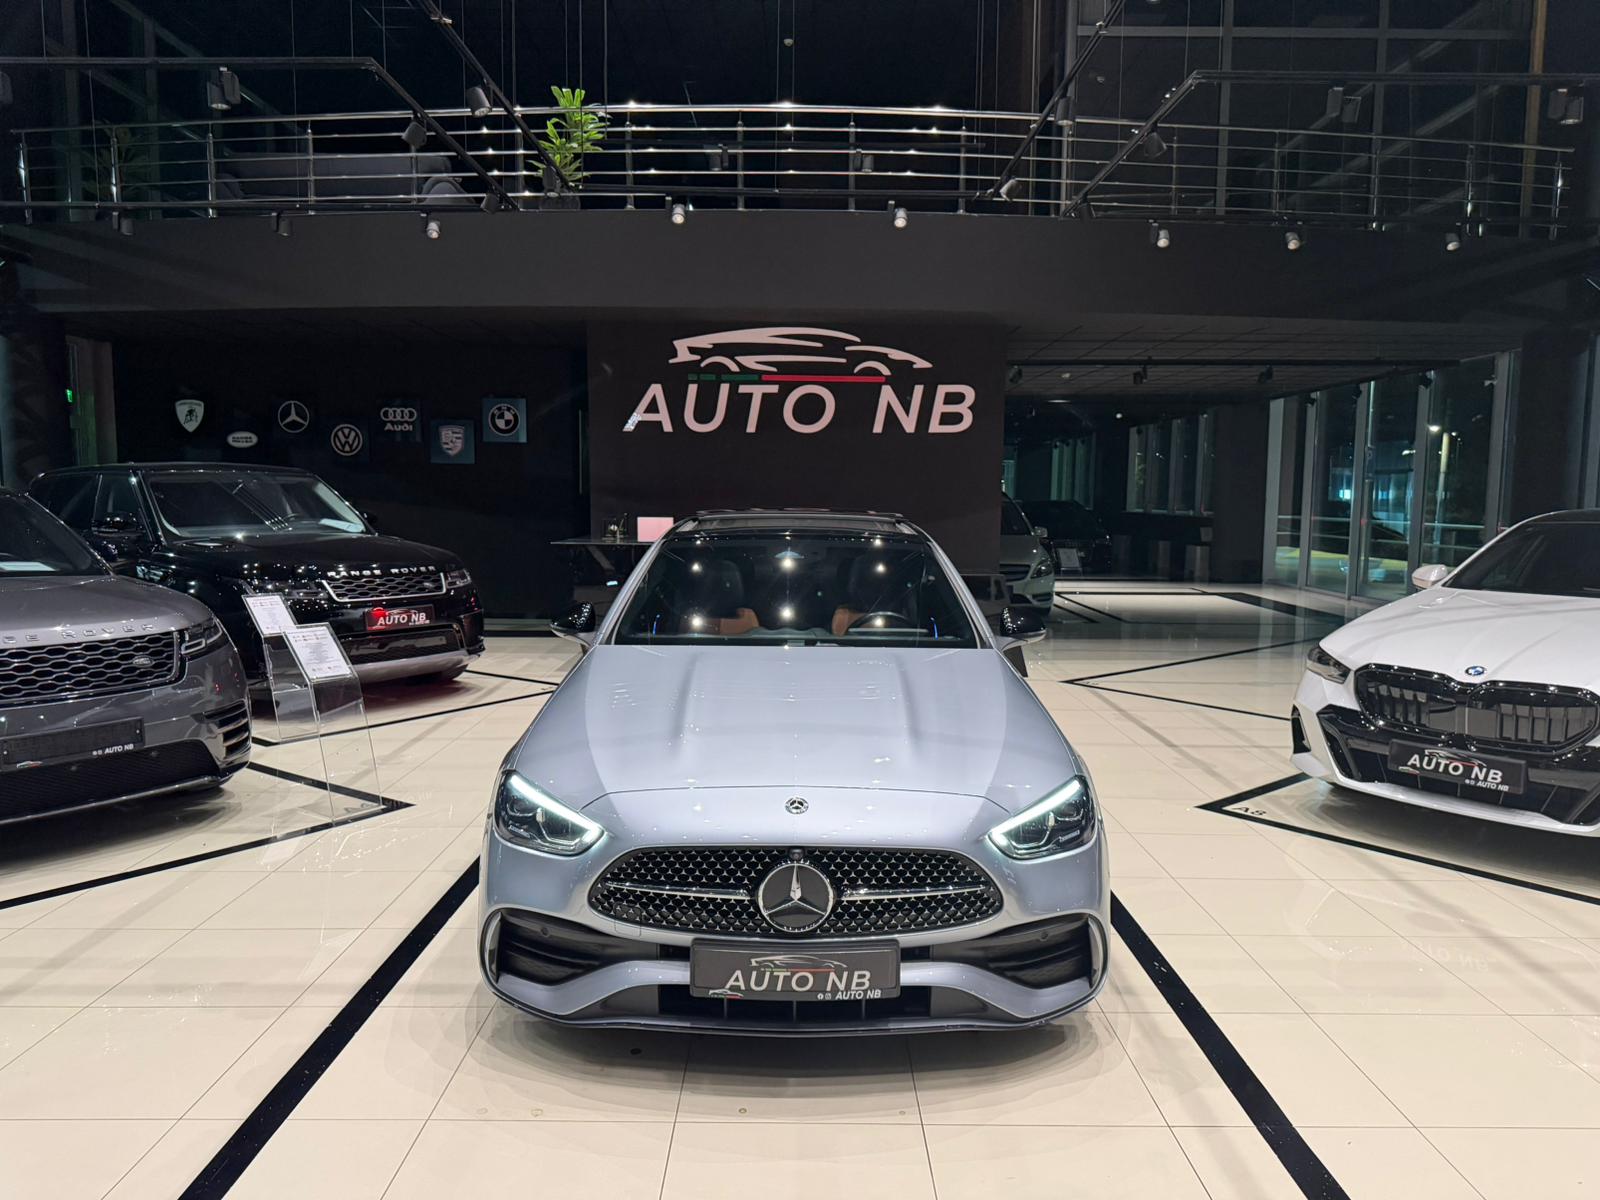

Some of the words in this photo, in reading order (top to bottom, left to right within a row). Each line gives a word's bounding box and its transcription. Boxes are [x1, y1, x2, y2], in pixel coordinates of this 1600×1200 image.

[622, 383, 837, 434] AUTO
[871, 383, 977, 434] NB
[383, 422, 414, 432] Audi
[326, 569, 383, 578] RANGE
[390, 565, 436, 575] ROVER
[377, 614, 408, 626] AUTO
[411, 612, 426, 623] NB
[61, 623, 155, 640] ROVER
[104, 745, 123, 754] AUTO
[124, 743, 134, 751] NB
[1407, 754, 1464, 776] AUTO
[1470, 765, 1503, 783] NB
[1476, 780, 1497, 789] AUTO
[1497, 784, 1509, 792] NB
[724, 969, 813, 992] AUTO
[826, 970, 872, 991] NB
[835, 991, 864, 1000] AUTO
[866, 989, 882, 999] NB
